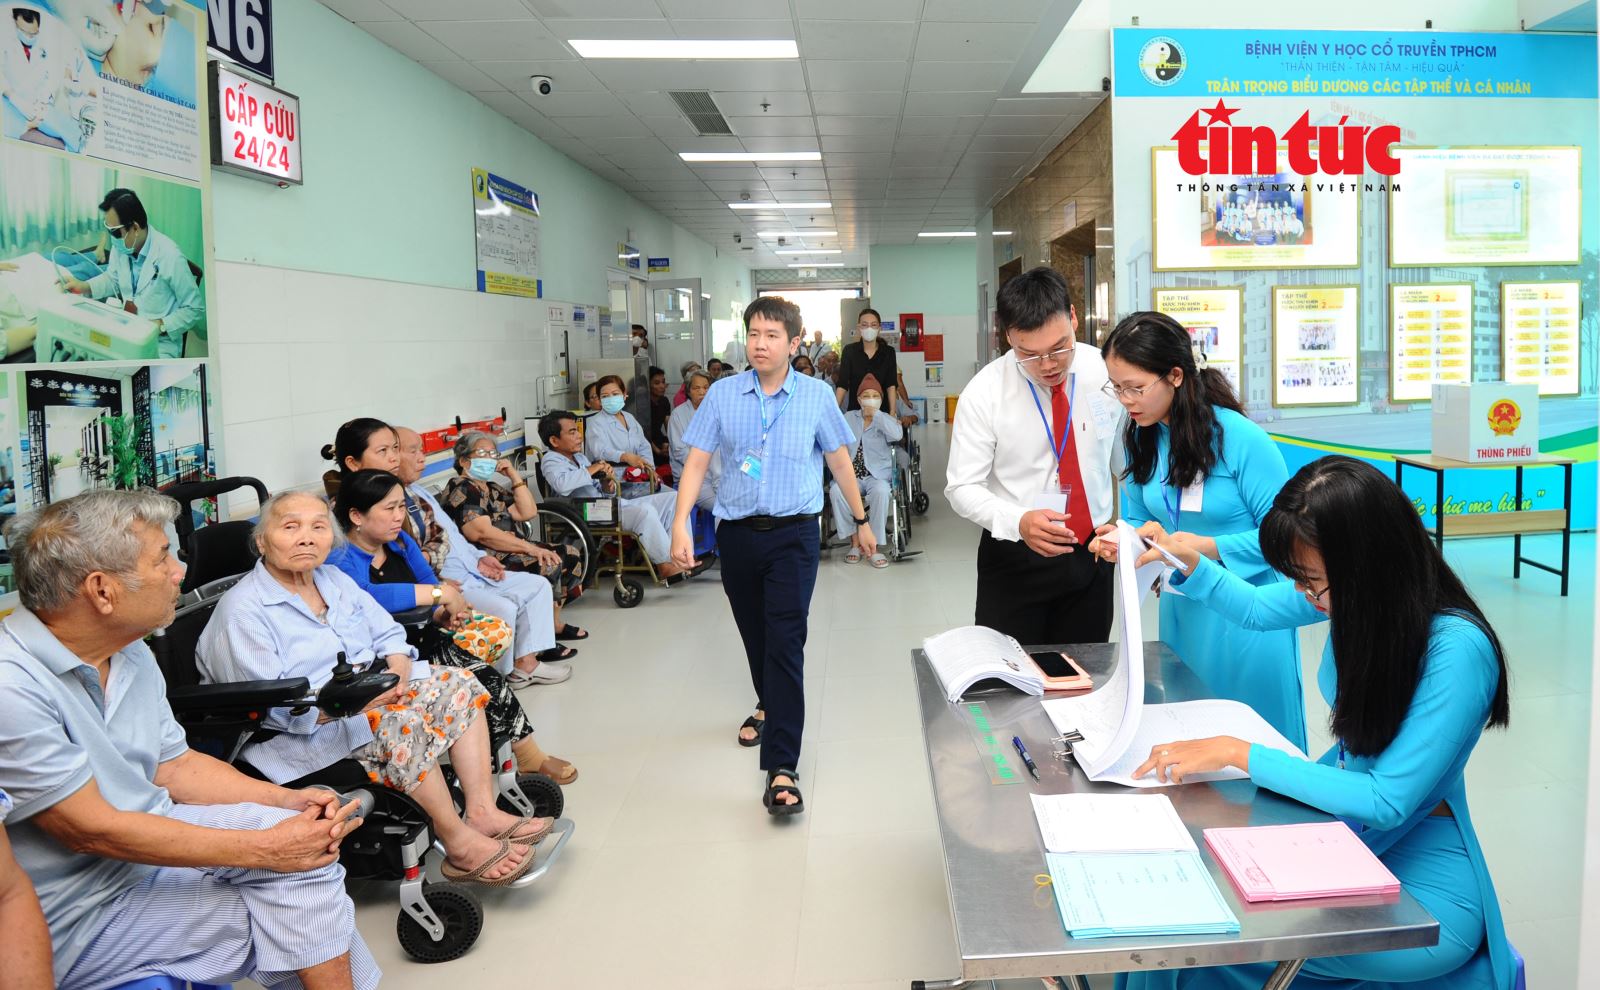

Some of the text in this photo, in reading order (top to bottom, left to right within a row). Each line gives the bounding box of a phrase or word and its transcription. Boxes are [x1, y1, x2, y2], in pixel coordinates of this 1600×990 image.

[1245, 38, 1497, 59] BỆNH VIỆN Y HỌC CỔ TRUYỀN TPHCM
[1316, 61, 1345, 73] THIỆN
[1380, 61, 1401, 72] TÂM
[1412, 62, 1434, 74] HIỆU
[98, 71, 119, 84] CHÂM
[119, 77, 133, 89] CỨU
[184, 102, 196, 110] CAO
[1206, 74, 1532, 96] TRÂN TRỌNG BIỂU DƯƠNG CÁC TẬP THỂ VÀ CÁ NHÂN
[225, 82, 258, 127] CẤP
[263, 99, 295, 142] CỨU
[234, 130, 290, 172] 24/24
[1203, 303, 1209, 311] 2
[1476, 444, 1532, 459] THÙNG PHIẾU
